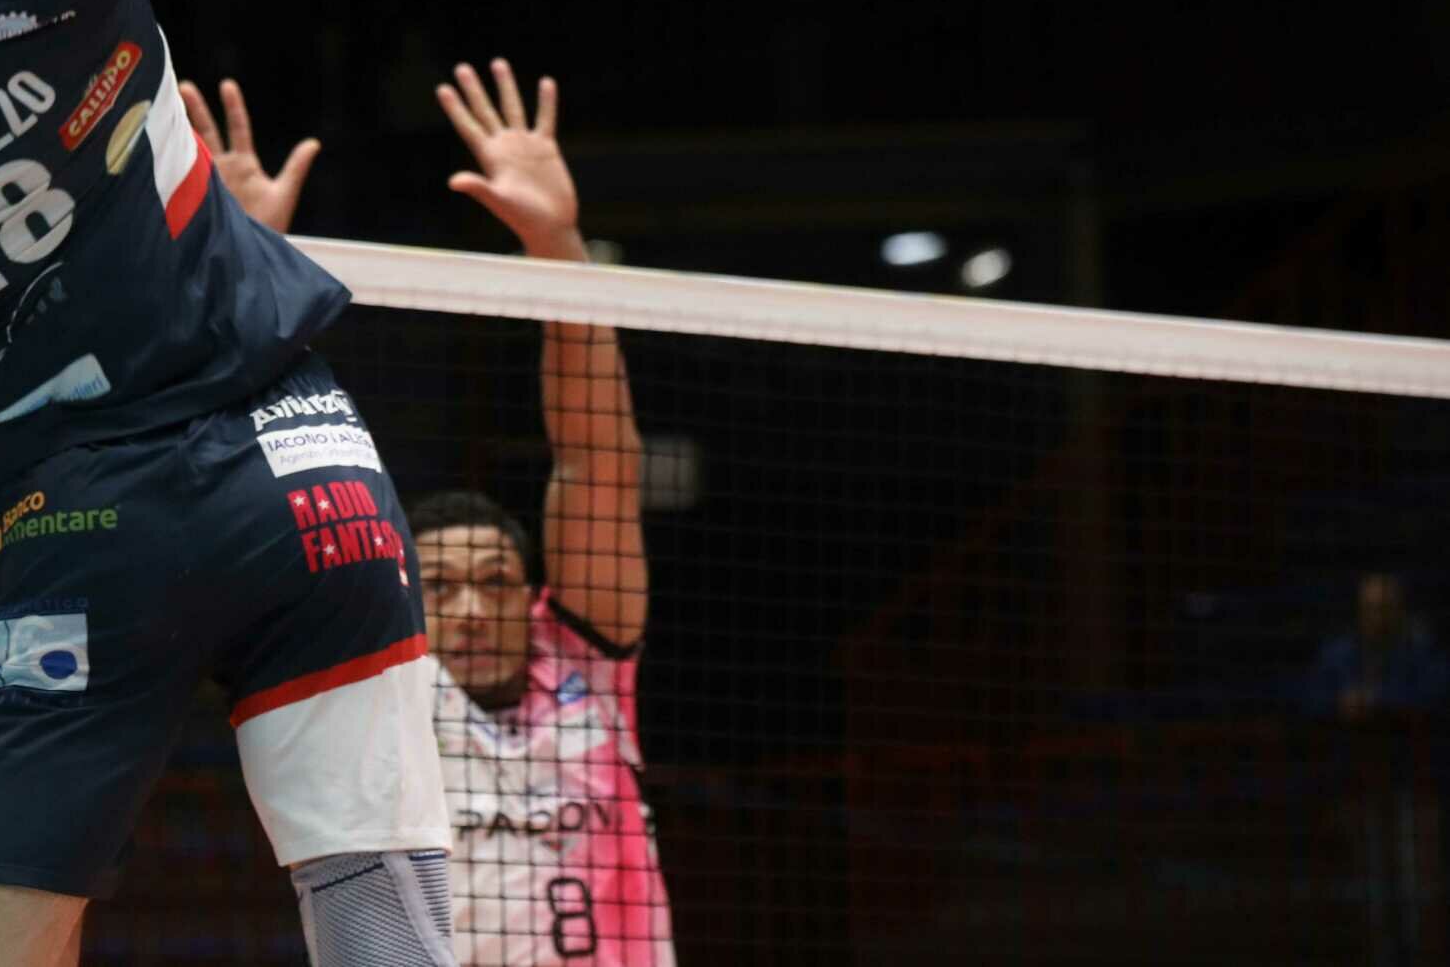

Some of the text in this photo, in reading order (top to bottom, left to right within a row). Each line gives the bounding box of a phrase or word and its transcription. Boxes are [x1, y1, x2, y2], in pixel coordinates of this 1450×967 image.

[68, 50, 131, 136] CALLIPO
[266, 432, 329, 453] IACONO
[286, 480, 380, 531] RADIO
[547, 877, 597, 959] 8
